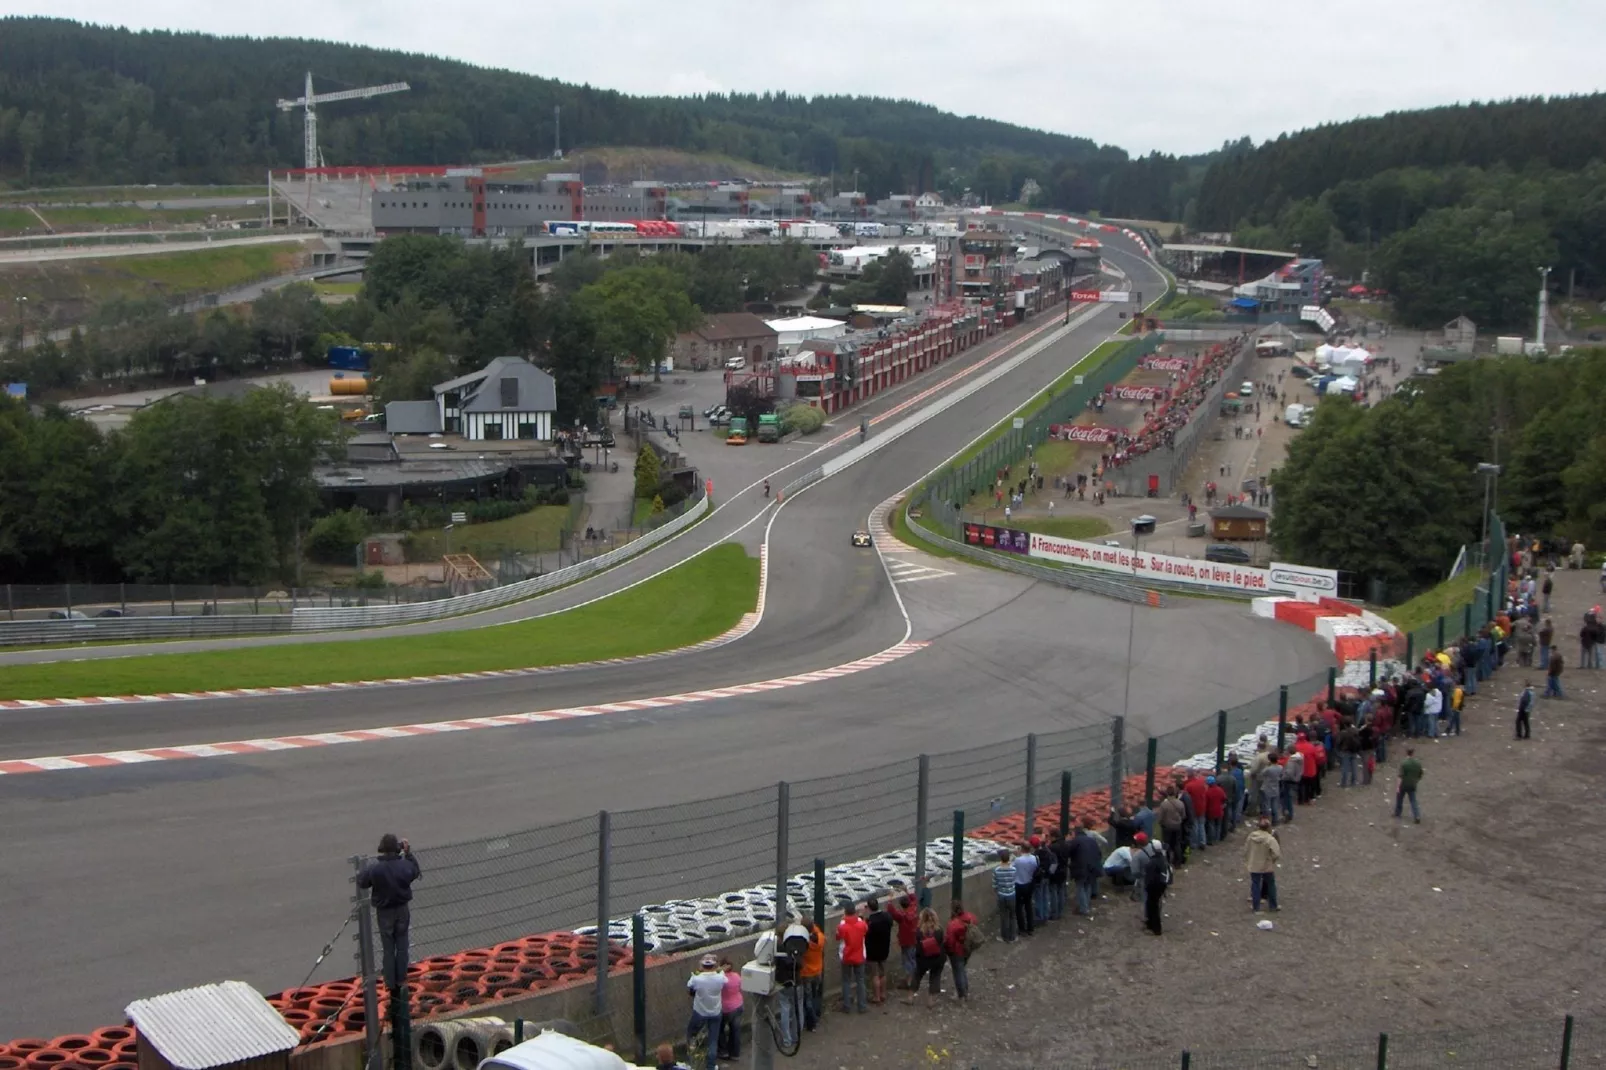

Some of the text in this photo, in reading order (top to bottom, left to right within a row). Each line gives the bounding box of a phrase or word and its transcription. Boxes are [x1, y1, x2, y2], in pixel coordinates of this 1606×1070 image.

[1071, 291, 1099, 300] TOTAL
[1151, 358, 1183, 370] CocaCola
[1119, 386, 1154, 400] CocaCola
[1068, 426, 1109, 442] CocaCola
[1032, 536, 1037, 550] A
[1038, 537, 1090, 561] Francorchamps,
[1093, 550, 1101, 561] on
[1103, 551, 1117, 564] met
[1118, 551, 1129, 566] les
[1131, 557, 1146, 570] gaz.
[1150, 556, 1163, 572] Sur
[1165, 559, 1172, 573] la
[1173, 563, 1196, 580] route,
[1199, 568, 1210, 579] on
[1212, 566, 1230, 583] lève
[1234, 569, 1242, 584] le
[1244, 572, 1266, 588] pied.
